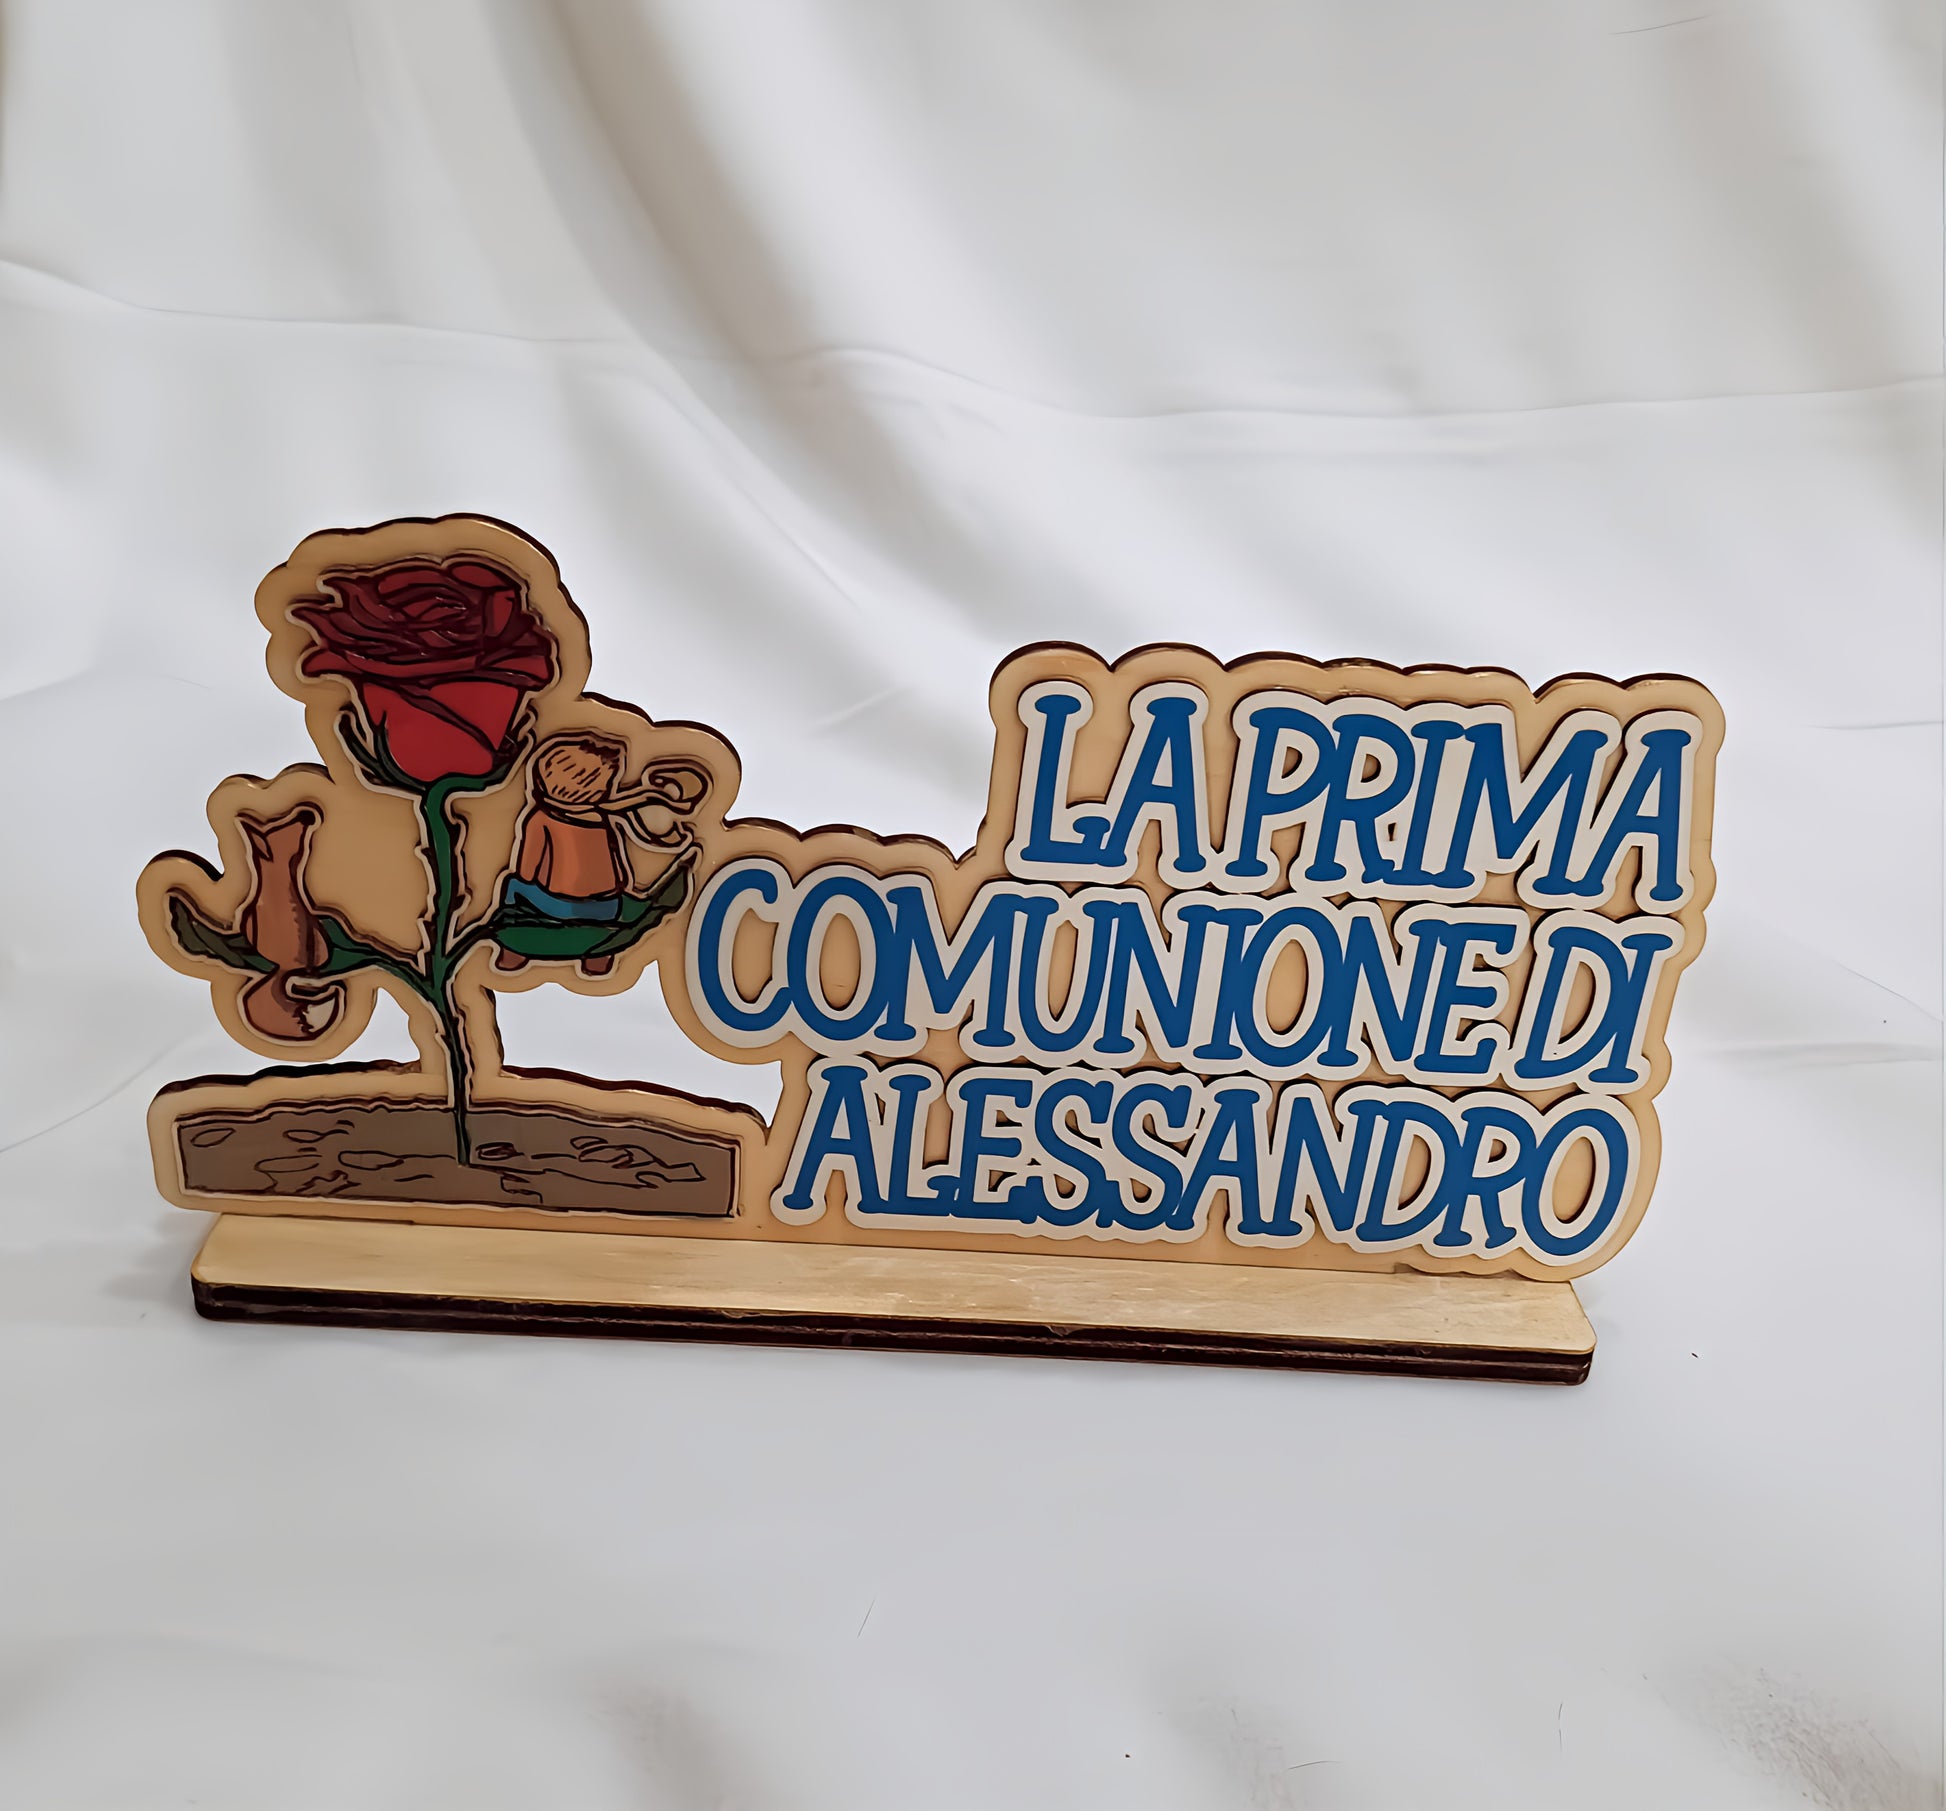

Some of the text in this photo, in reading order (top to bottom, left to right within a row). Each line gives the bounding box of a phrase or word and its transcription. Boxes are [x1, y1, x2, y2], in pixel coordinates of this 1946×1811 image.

[1020, 694, 1691, 902] LA PRIMA
[698, 868, 1673, 1084] COMUNIONE DI
[783, 1065, 1629, 1256] ALESSANDRO
